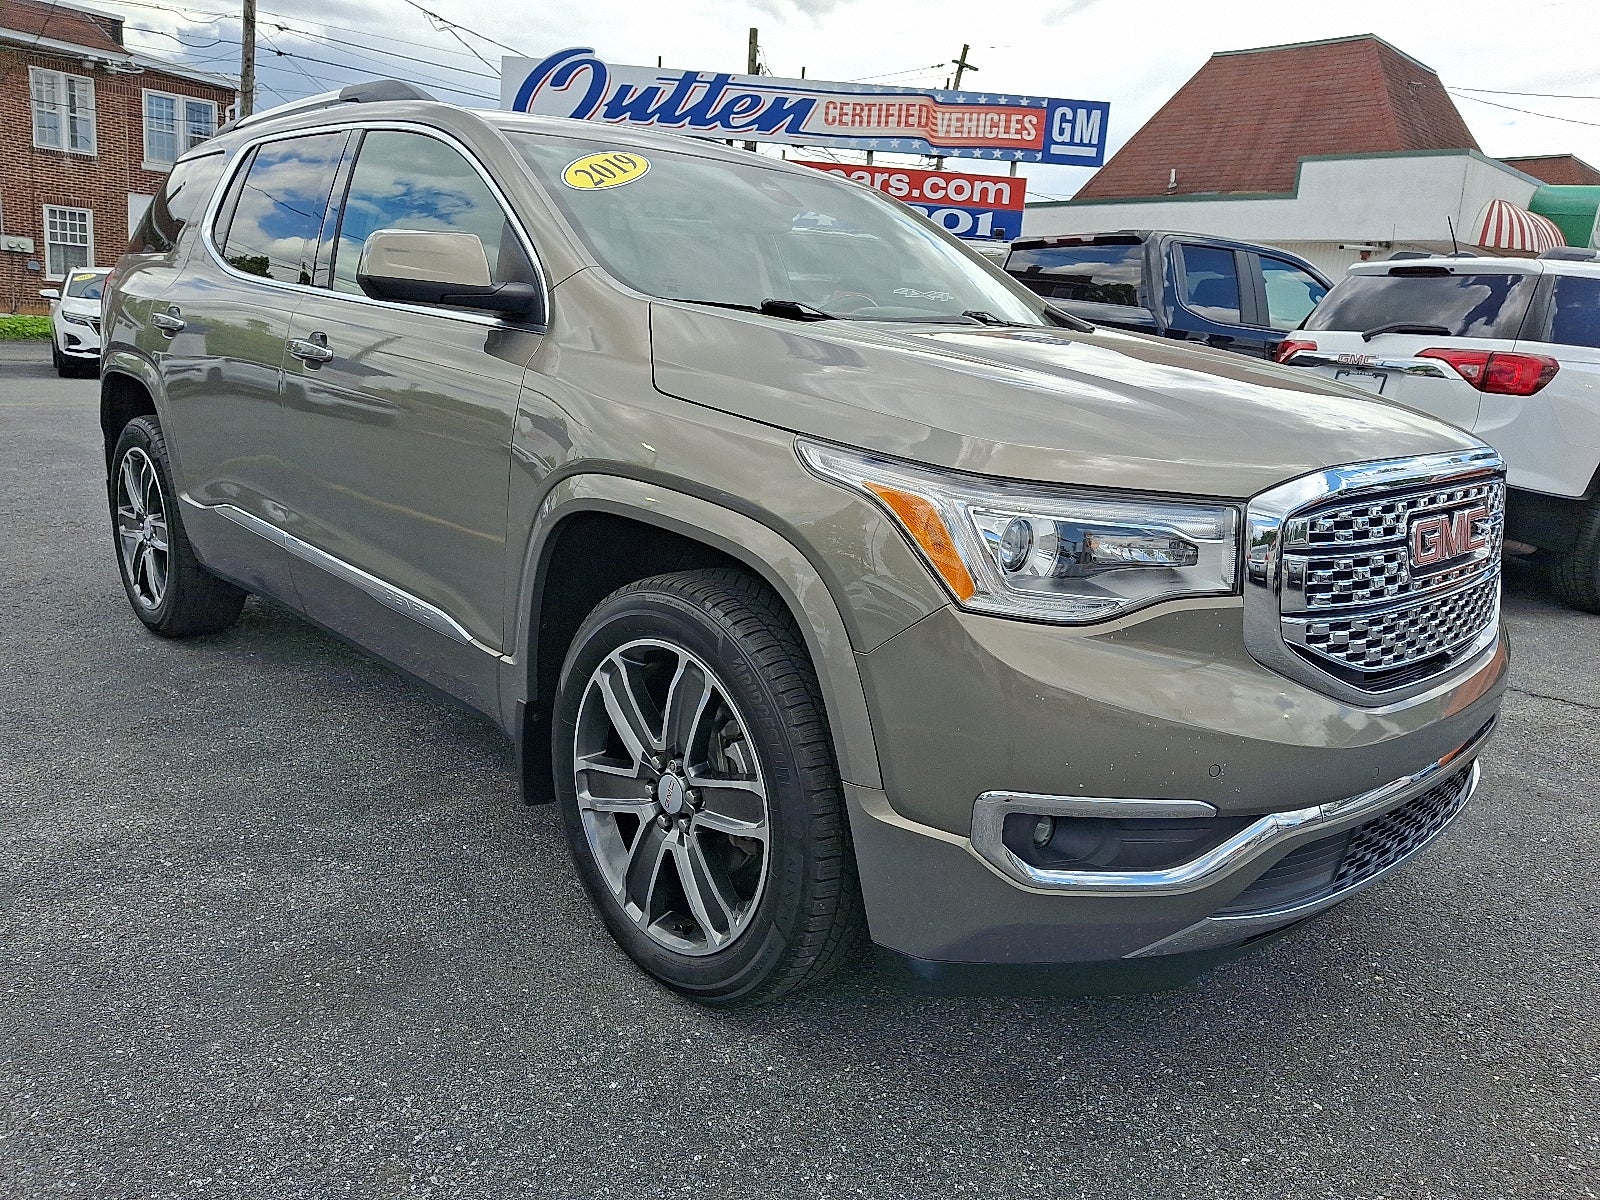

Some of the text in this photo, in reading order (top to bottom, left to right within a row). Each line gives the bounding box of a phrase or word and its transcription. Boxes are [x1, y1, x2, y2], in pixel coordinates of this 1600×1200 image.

[512, 47, 1038, 141] Outten CERTIFIED VEHICLES
[1051, 107, 1102, 144] GM
[574, 155, 637, 187] 2019
[908, 205, 994, 236] 01
[1337, 353, 1379, 367] GMC
[1412, 505, 1487, 568] GMC
